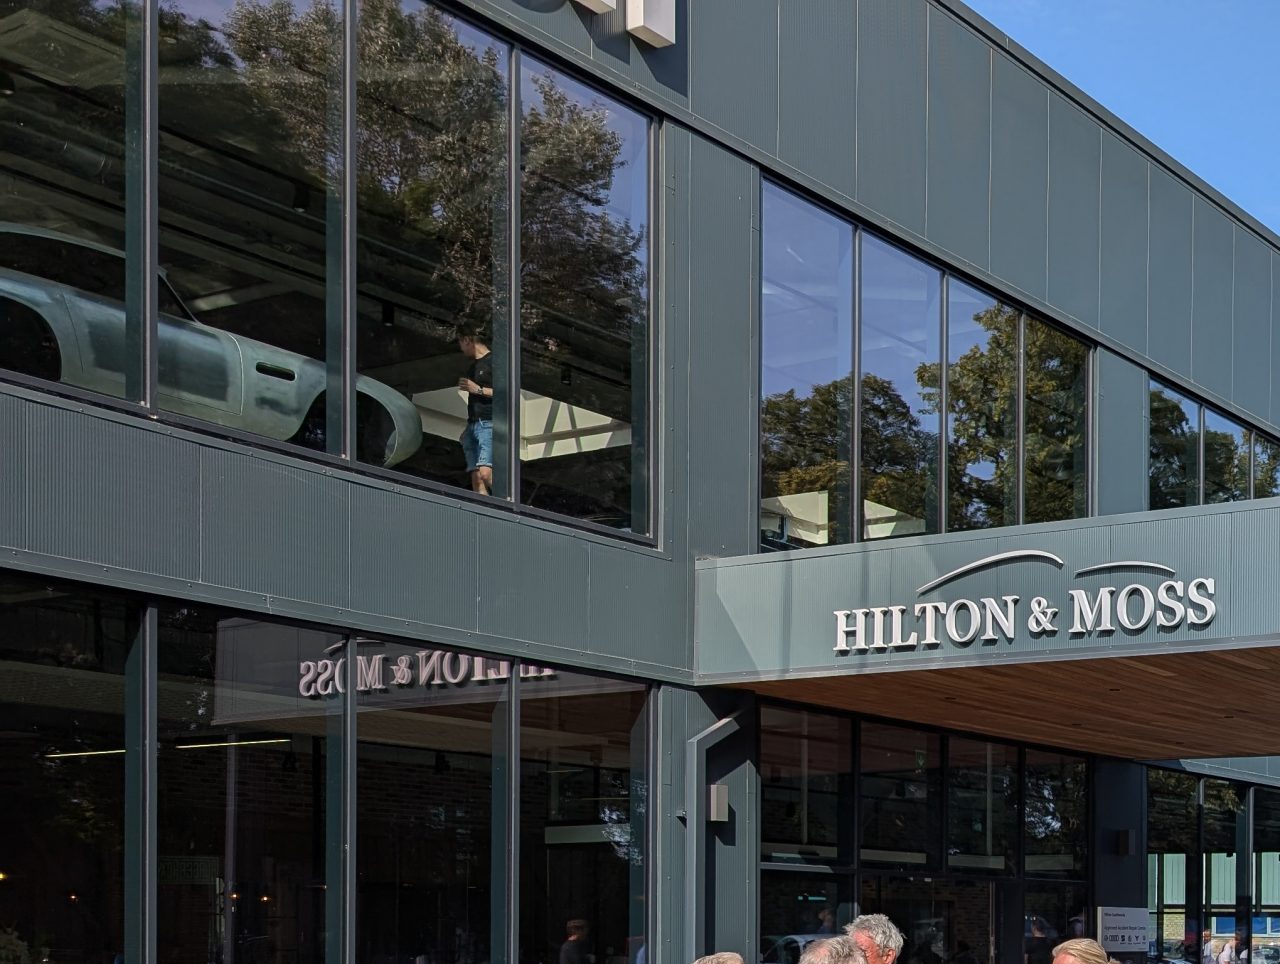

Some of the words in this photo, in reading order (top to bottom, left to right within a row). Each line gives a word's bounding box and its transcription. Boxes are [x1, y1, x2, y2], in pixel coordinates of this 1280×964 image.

[832, 595, 1020, 652] HILTON
[1027, 595, 1060, 633] &
[1068, 577, 1216, 633] MOSS
